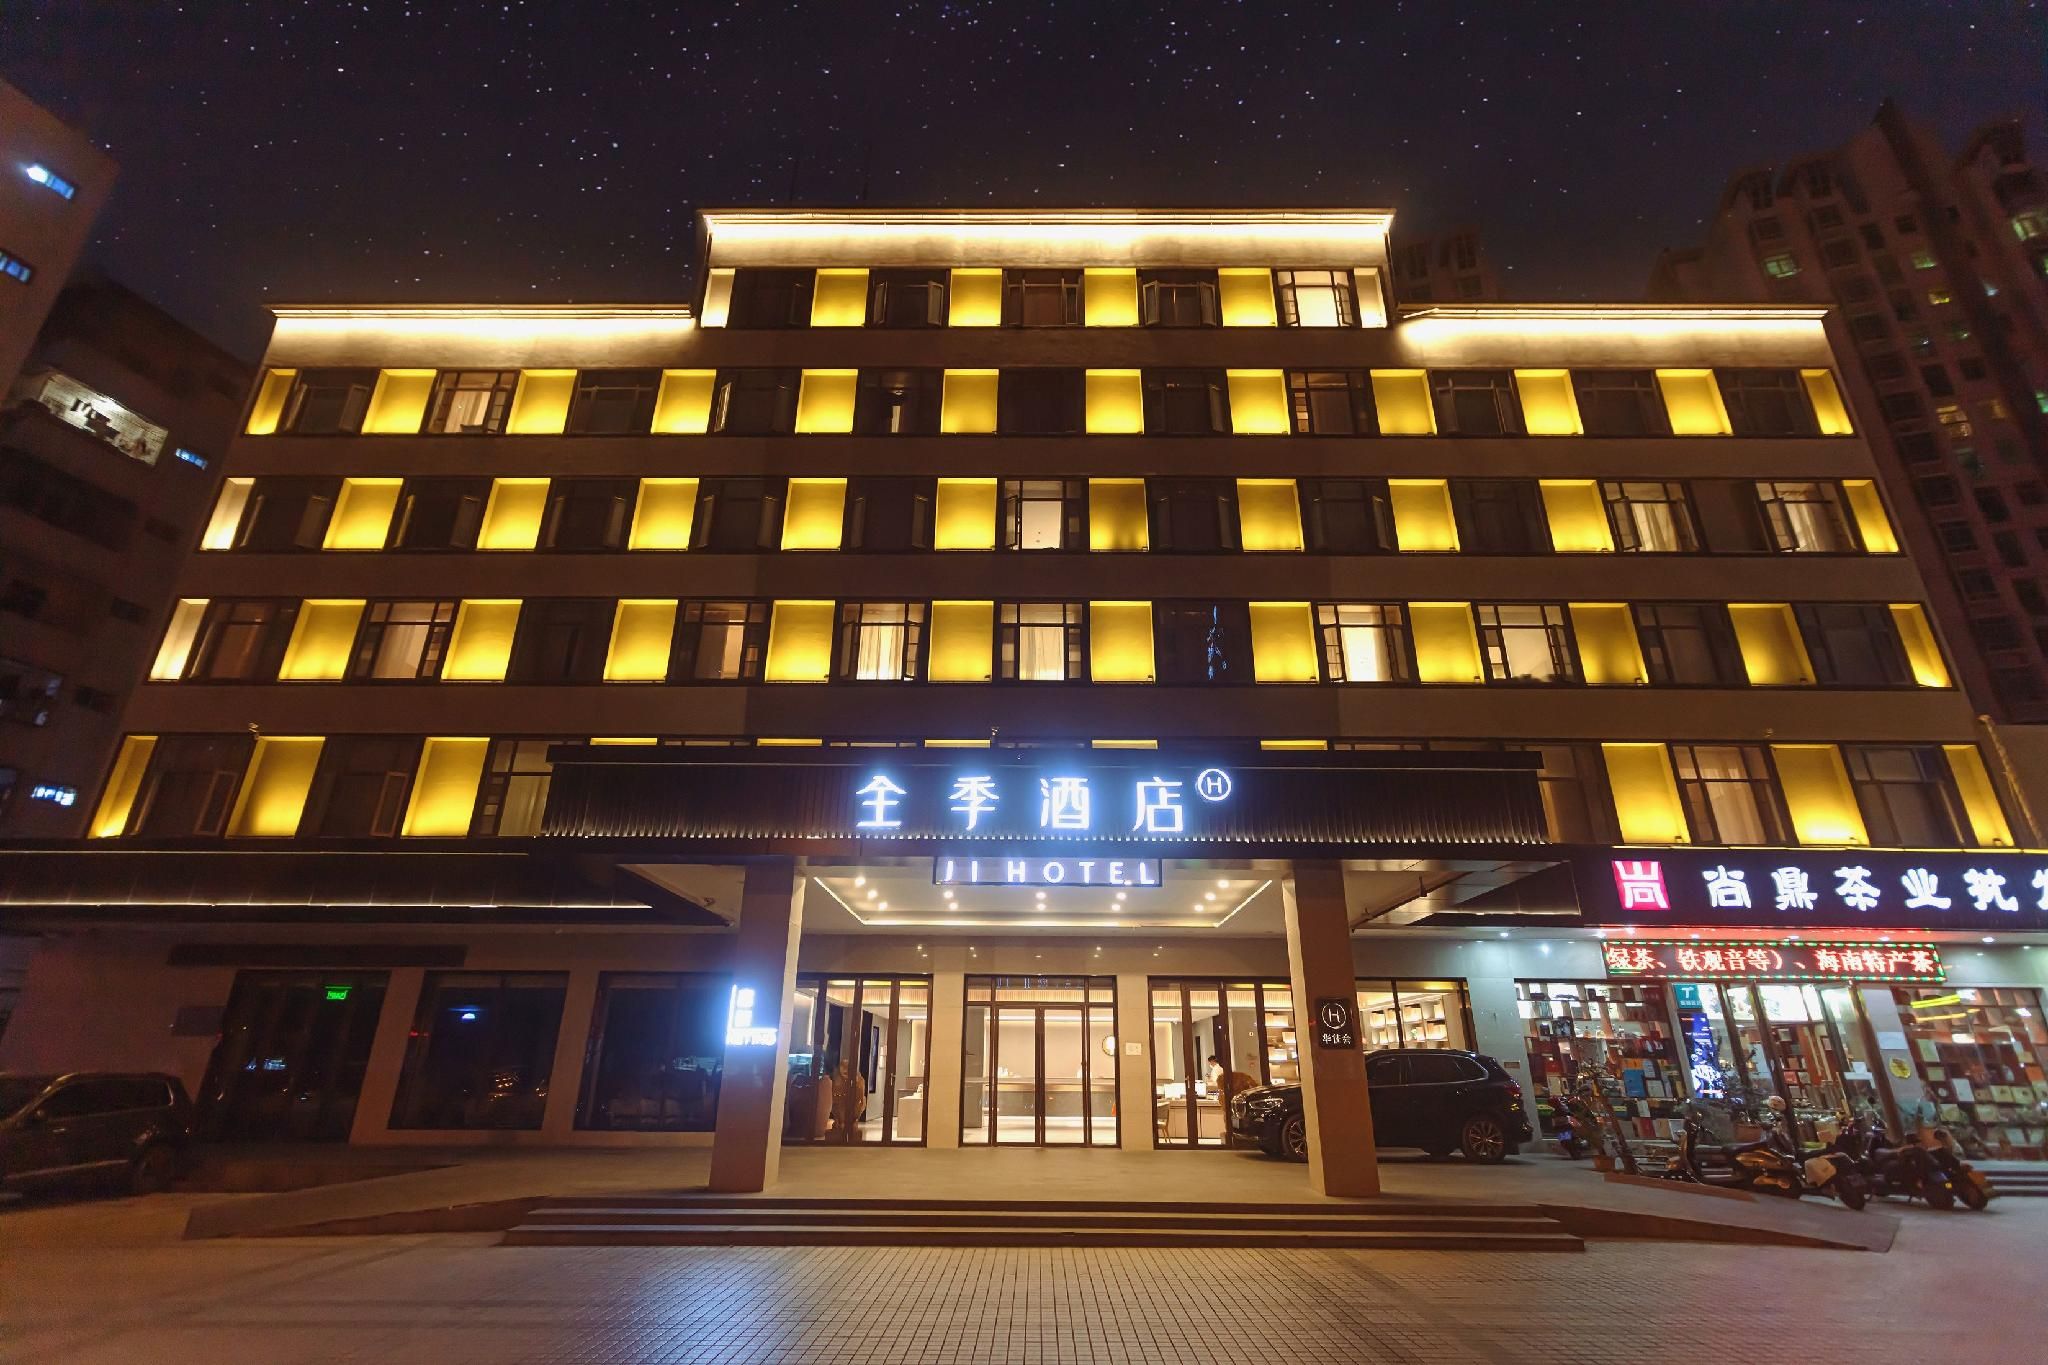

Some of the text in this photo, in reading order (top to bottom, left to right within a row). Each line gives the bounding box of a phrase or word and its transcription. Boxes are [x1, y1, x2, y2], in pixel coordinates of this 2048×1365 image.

[856, 775, 1184, 832] 全季酒店
[943, 860, 1155, 885] JI HOTEL
